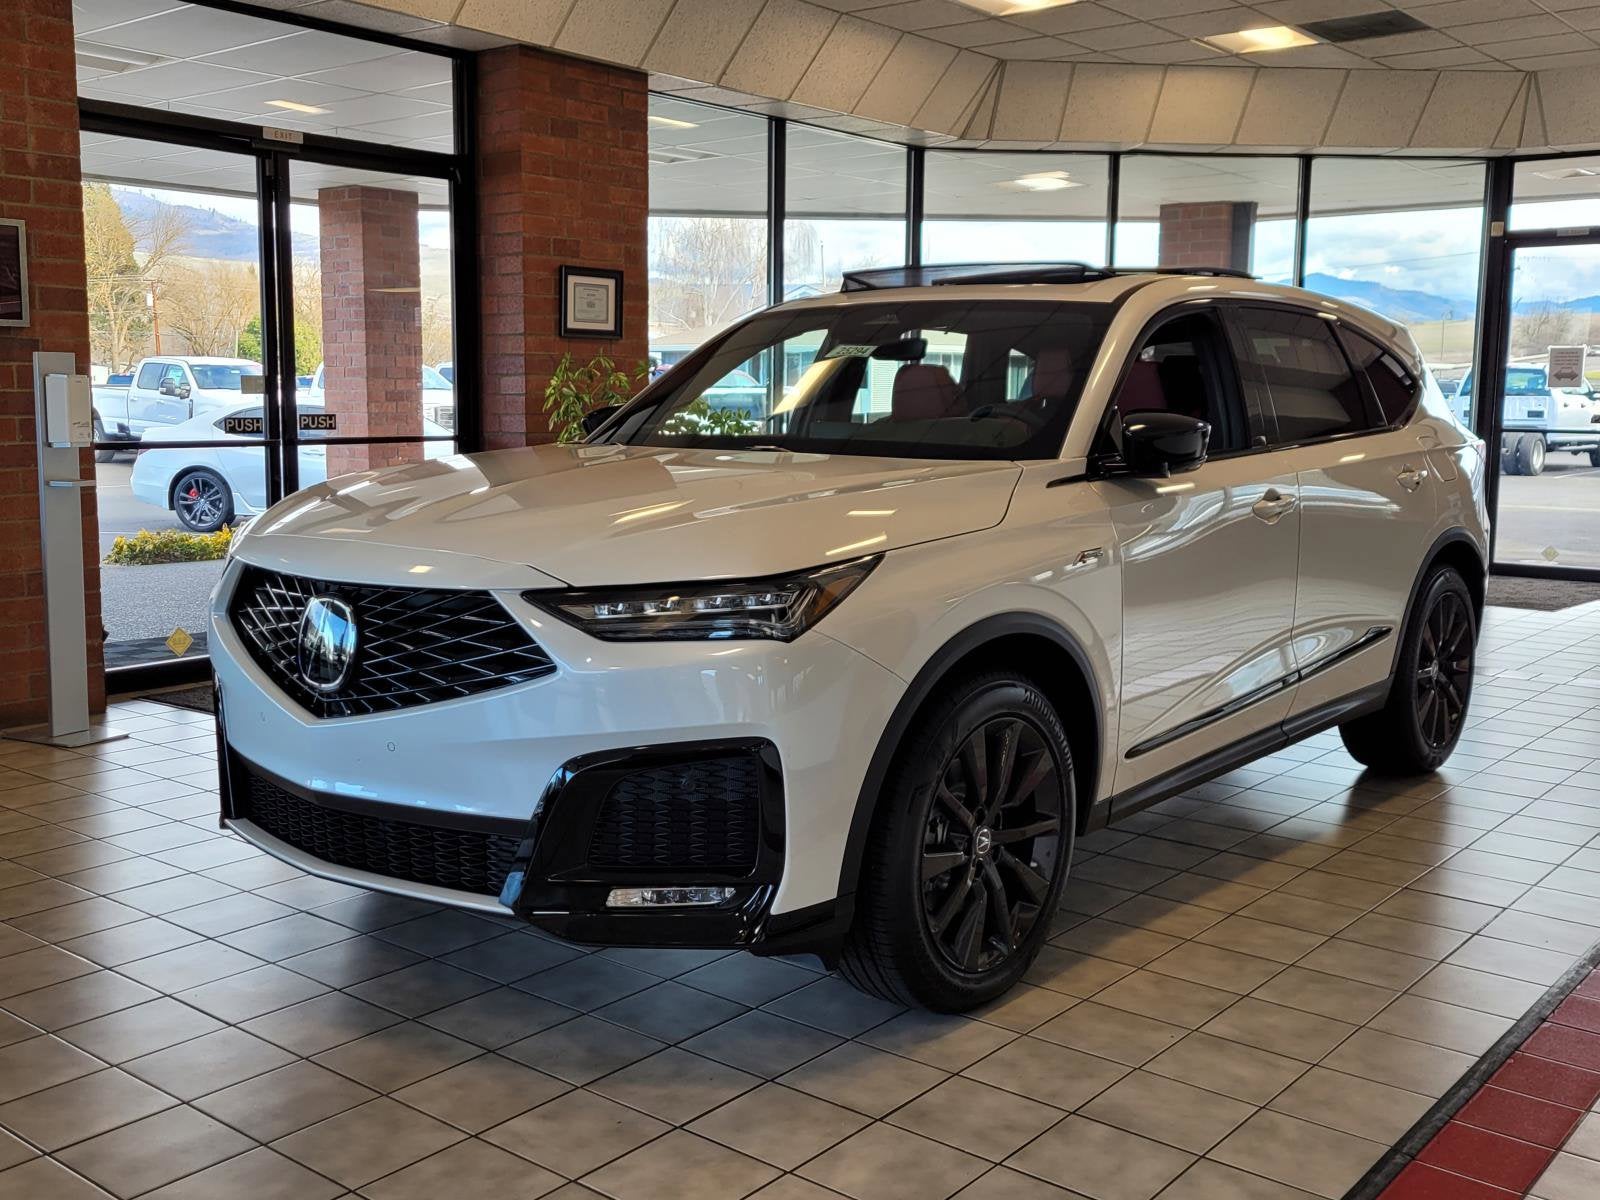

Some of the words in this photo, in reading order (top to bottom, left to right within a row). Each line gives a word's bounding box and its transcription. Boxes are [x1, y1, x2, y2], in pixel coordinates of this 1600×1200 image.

[274, 130, 294, 140] EXIT
[226, 419, 262, 432] PUSH
[300, 416, 335, 428] PUSH
